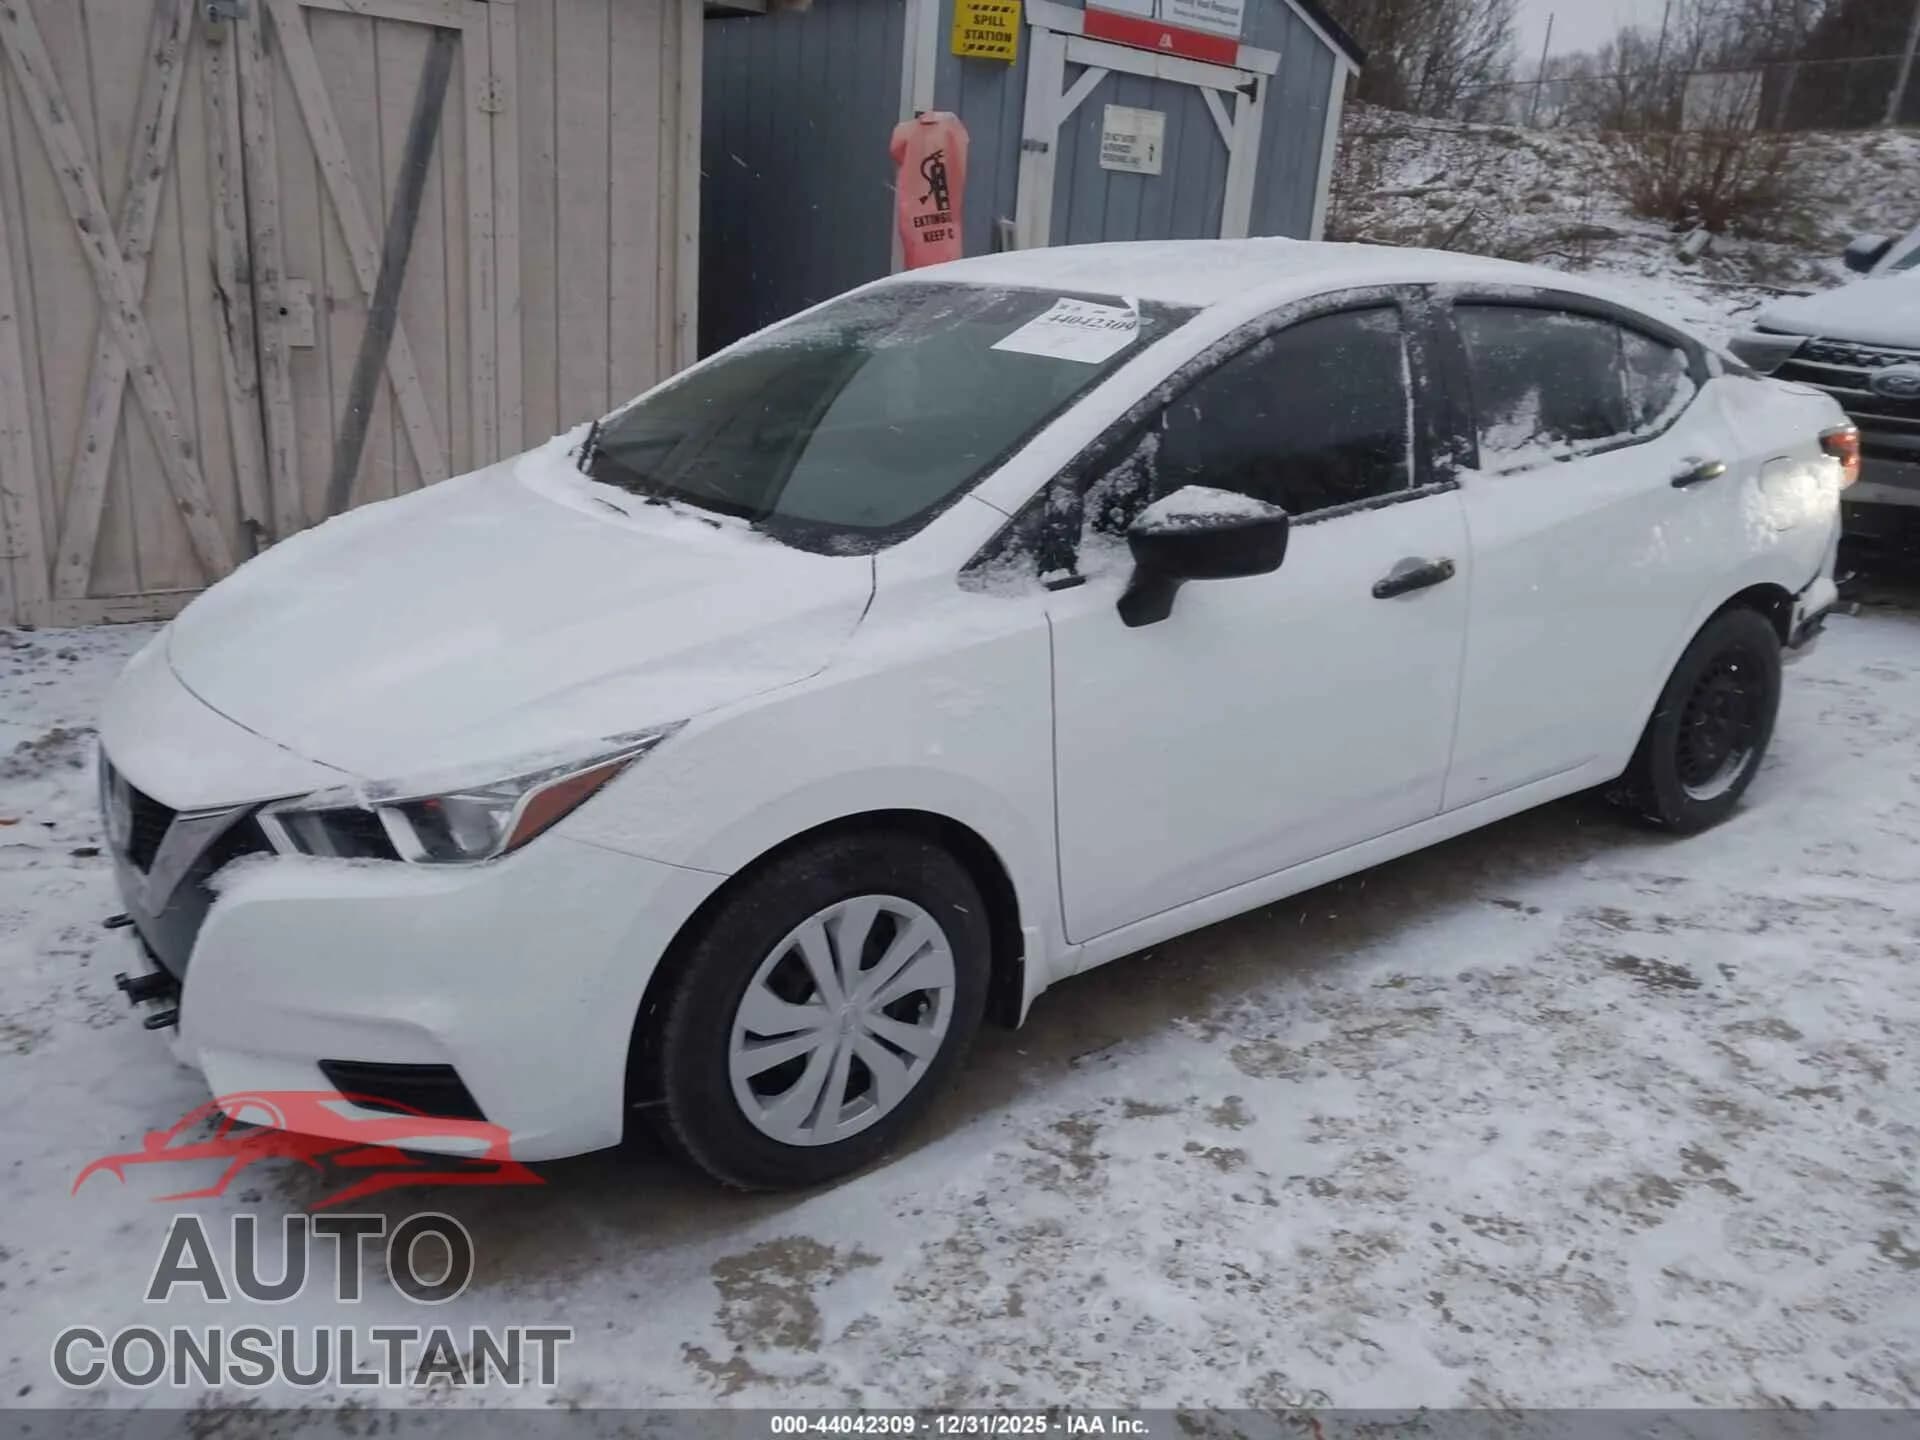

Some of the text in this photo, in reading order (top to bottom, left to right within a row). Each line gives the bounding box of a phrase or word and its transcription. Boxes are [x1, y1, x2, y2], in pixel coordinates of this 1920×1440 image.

[973, 14, 1006, 27] SPILL
[964, 29, 1012, 43] STATION
[923, 229, 945, 243] KEEP
